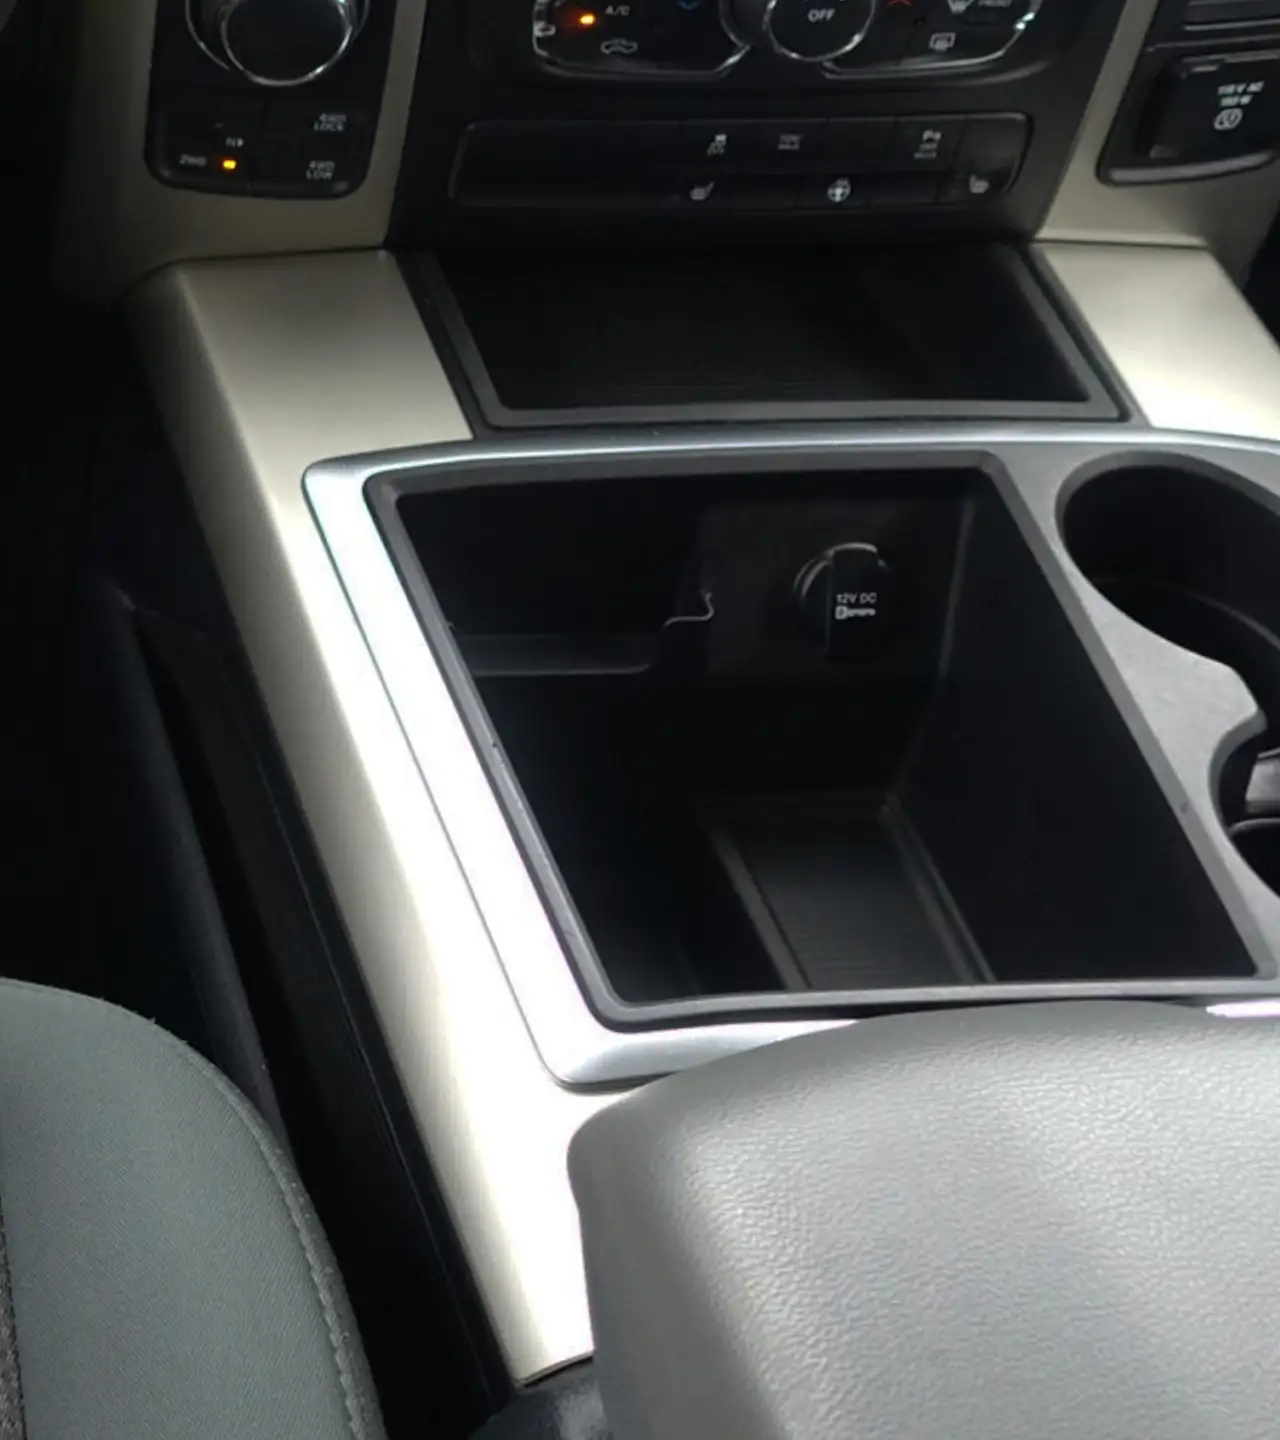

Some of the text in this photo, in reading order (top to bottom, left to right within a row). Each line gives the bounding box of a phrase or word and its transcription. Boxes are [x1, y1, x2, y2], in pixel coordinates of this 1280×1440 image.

[605, 4, 631, 17] A/C
[806, 7, 836, 23] OFF
[859, 592, 877, 604] DC
